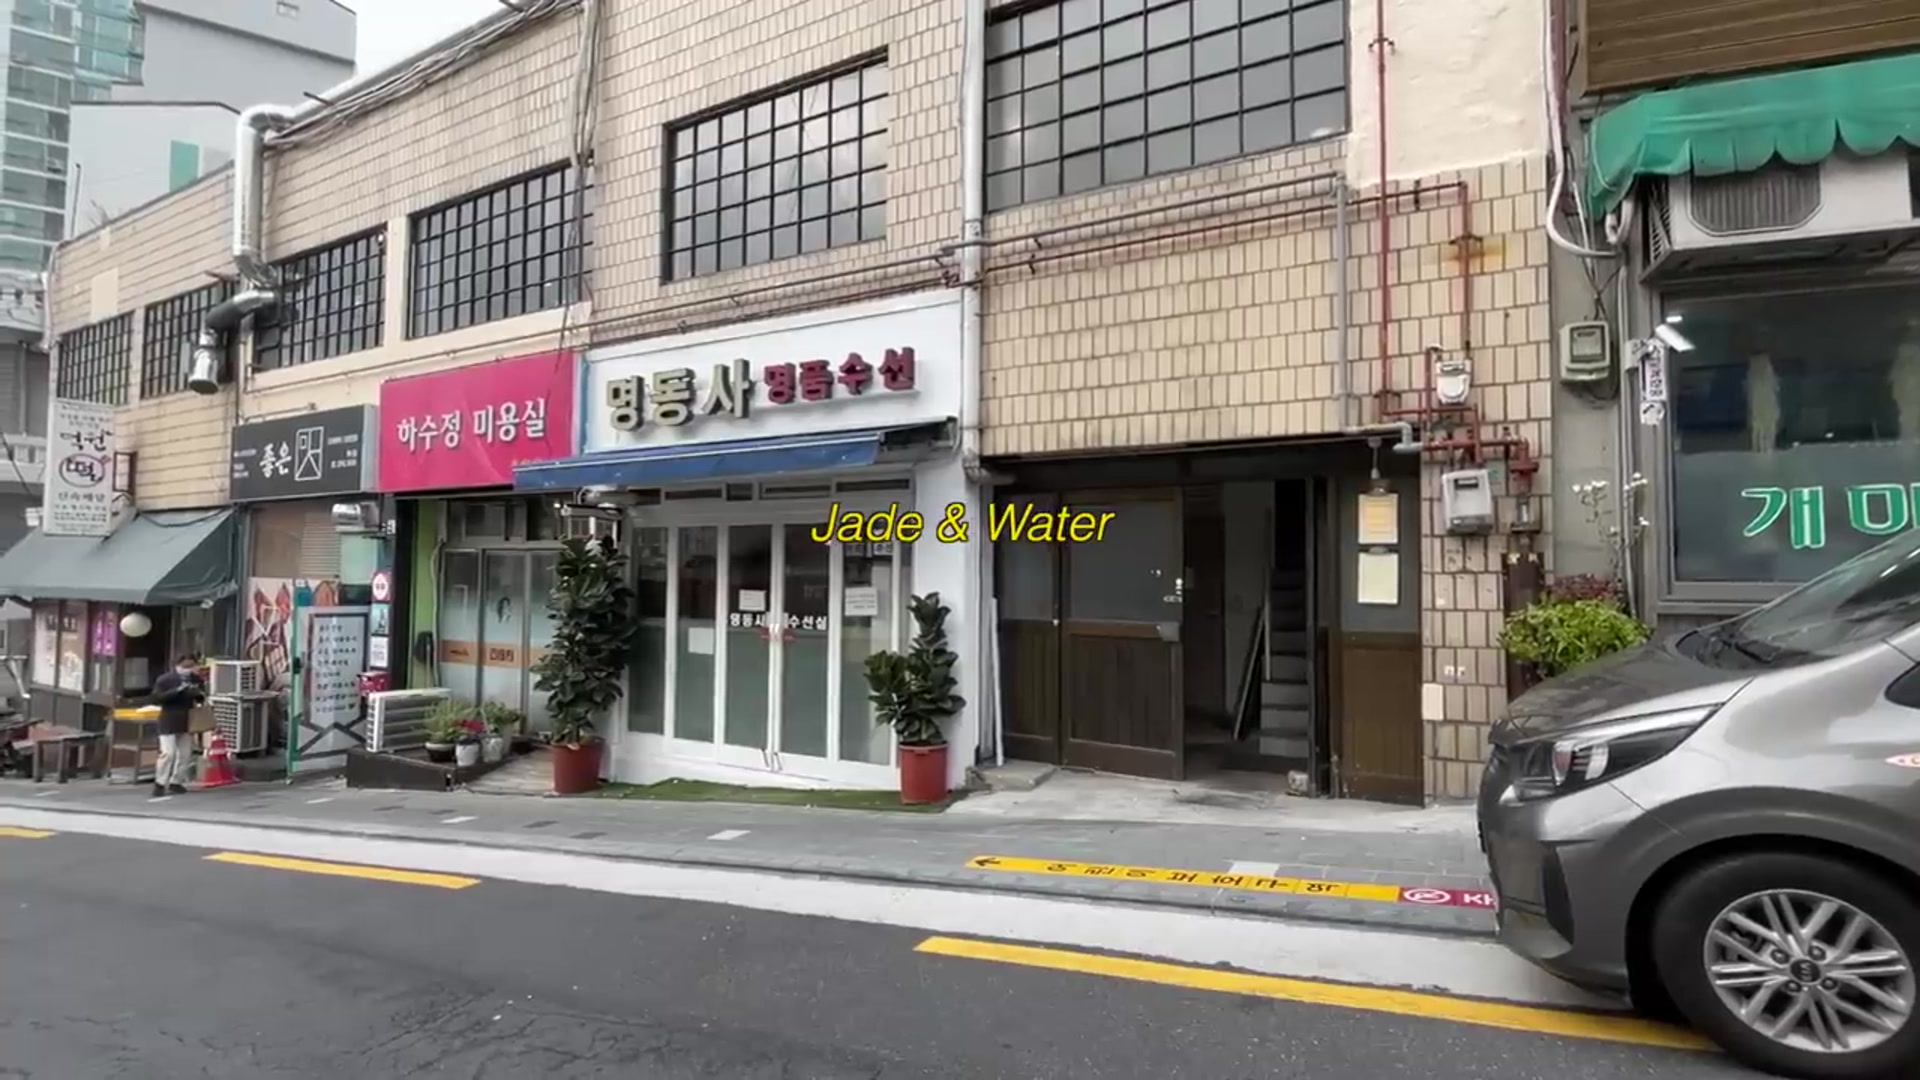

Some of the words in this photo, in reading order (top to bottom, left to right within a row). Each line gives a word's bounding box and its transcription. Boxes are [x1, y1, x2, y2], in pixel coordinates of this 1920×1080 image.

[606, 358, 754, 432] 명동사
[764, 346, 916, 405] 명품수선
[396, 409, 462, 452] 하수정
[472, 397, 546, 444] 미용실
[259, 441, 292, 478] 좋은
